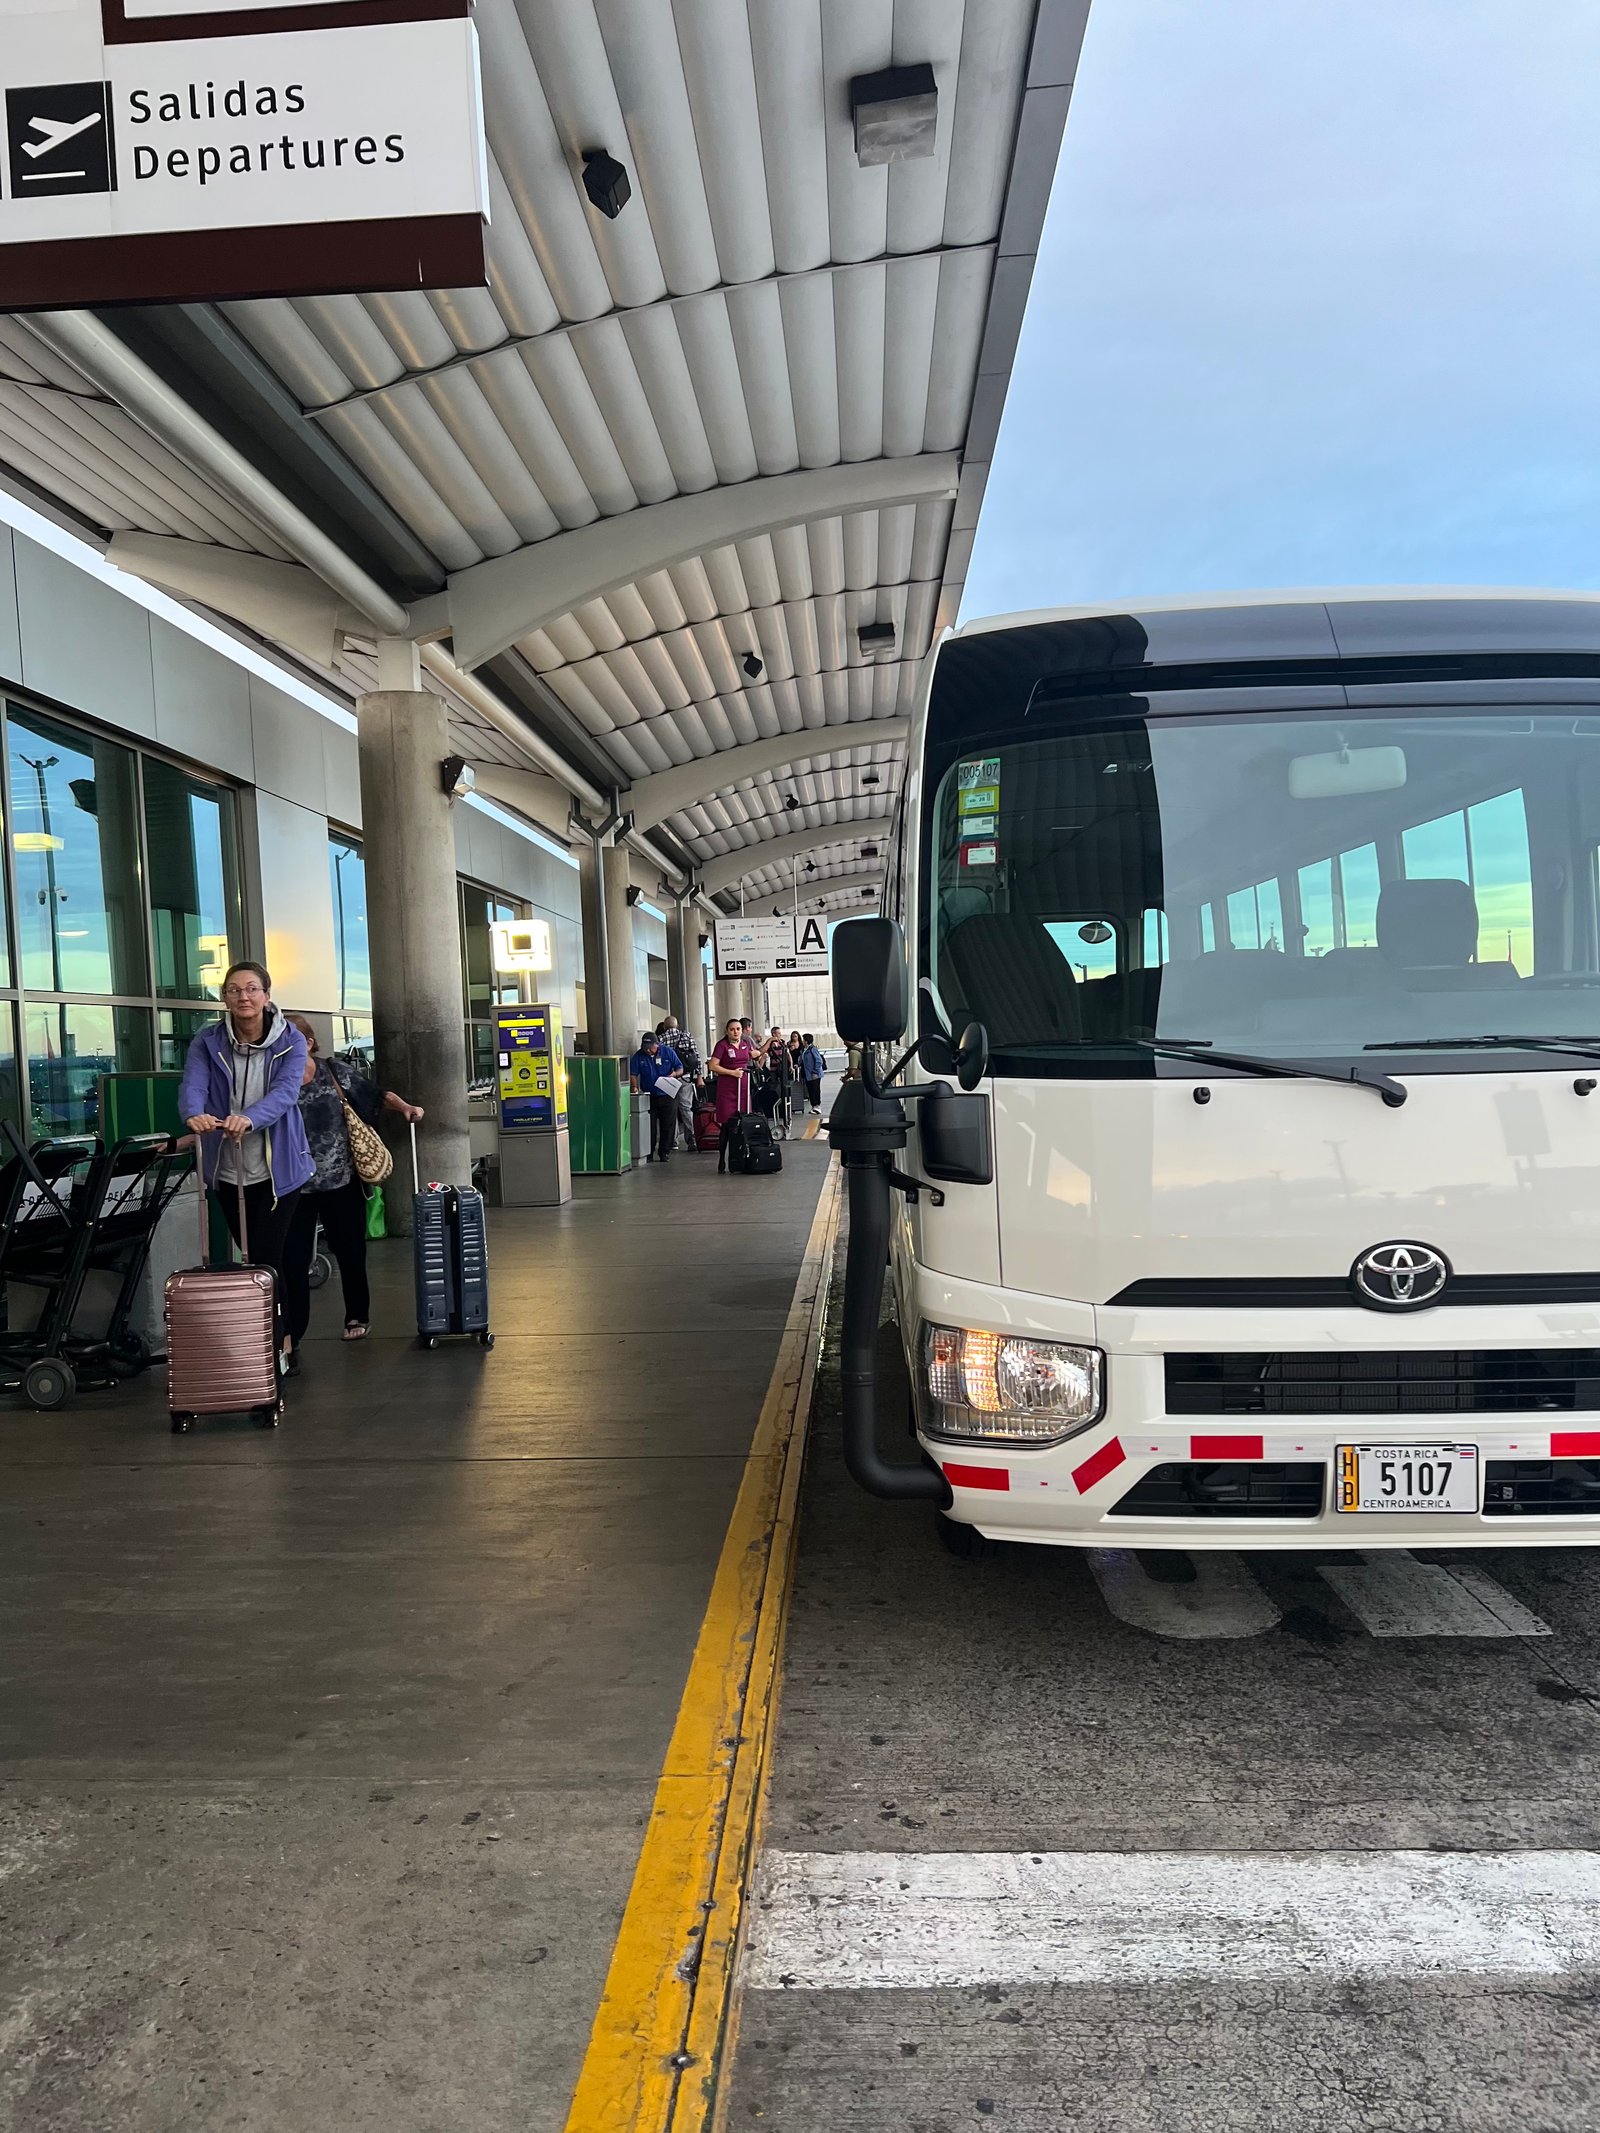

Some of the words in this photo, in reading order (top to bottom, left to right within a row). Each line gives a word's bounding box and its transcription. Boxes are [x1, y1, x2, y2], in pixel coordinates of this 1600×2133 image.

[129, 80, 305, 124] Salidas
[133, 134, 405, 185] Departures
[963, 763, 998, 779] 005107
[800, 918, 825, 950] A
[1375, 1450, 1410, 1459] COSTA
[1414, 1450, 1439, 1459] RICA
[1381, 1462, 1452, 1496] 5107
[1363, 1500, 1451, 1508] CENTROAMERICA
